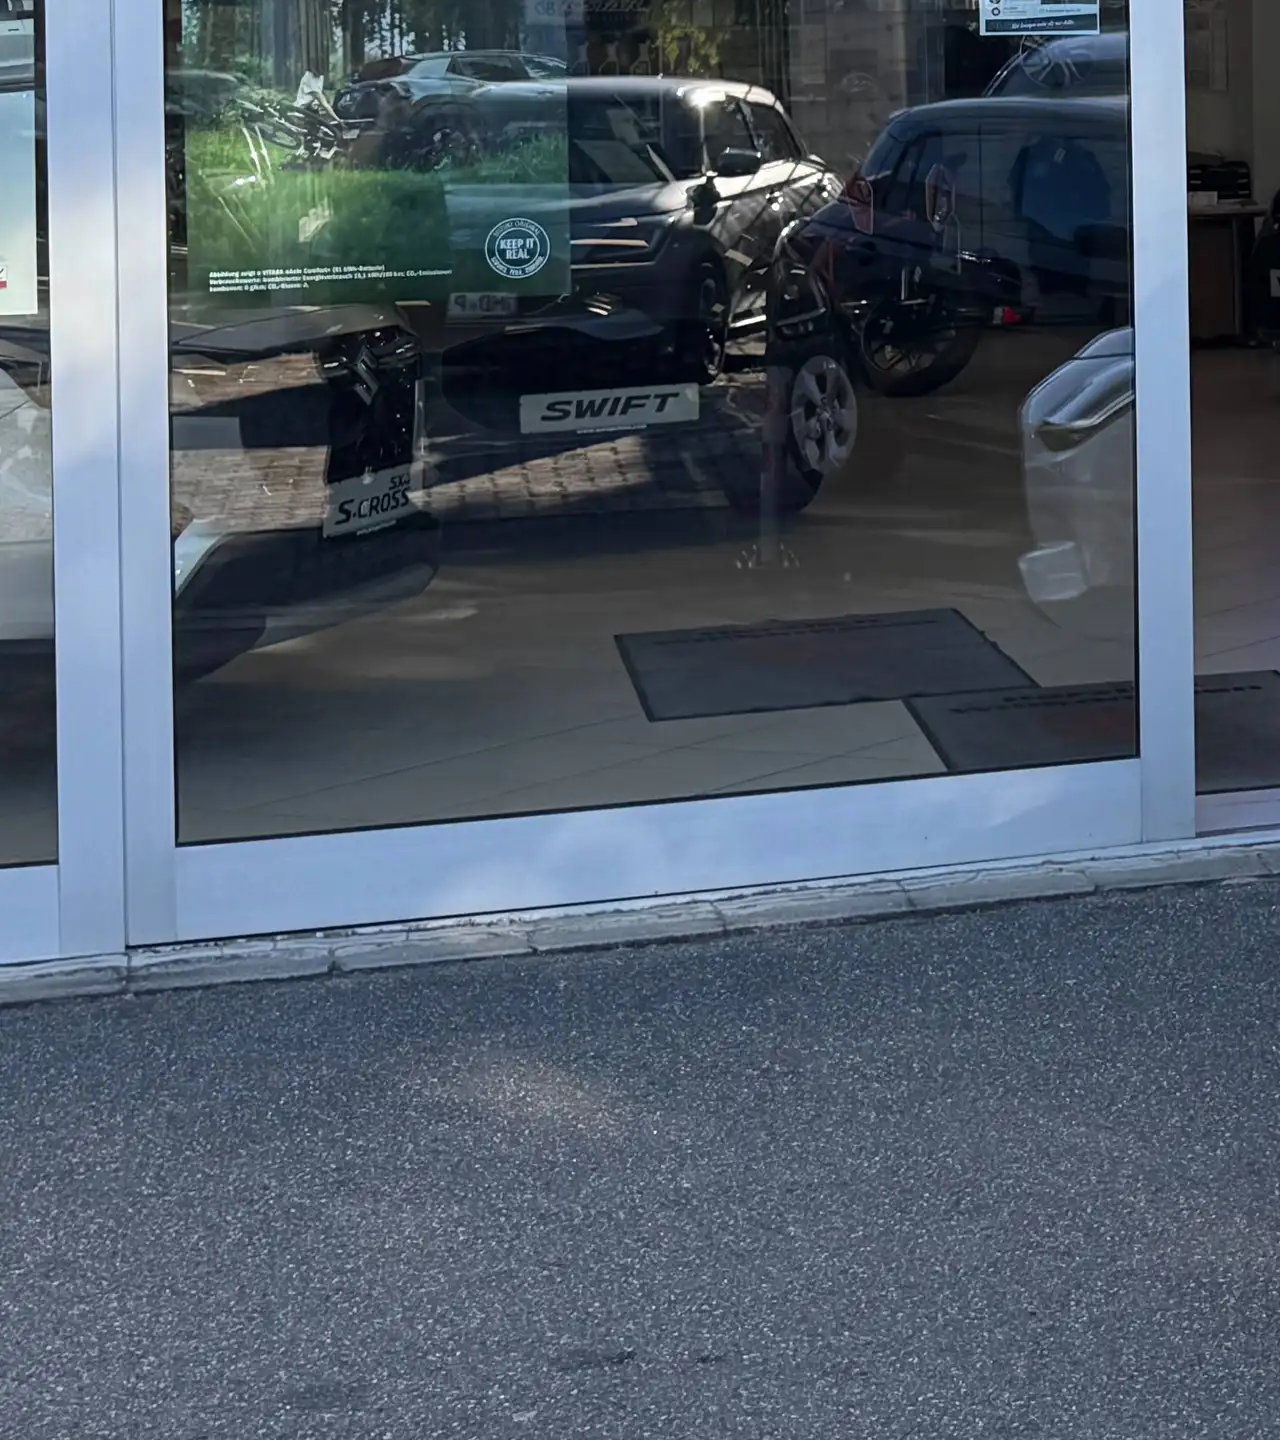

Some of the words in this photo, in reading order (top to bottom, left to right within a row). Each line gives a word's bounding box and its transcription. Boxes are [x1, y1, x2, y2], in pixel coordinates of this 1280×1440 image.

[500, 238, 524, 250] KEEP
[526, 237, 535, 249] IT
[506, 248, 530, 260] REAL
[540, 392, 680, 422] SWIFT
